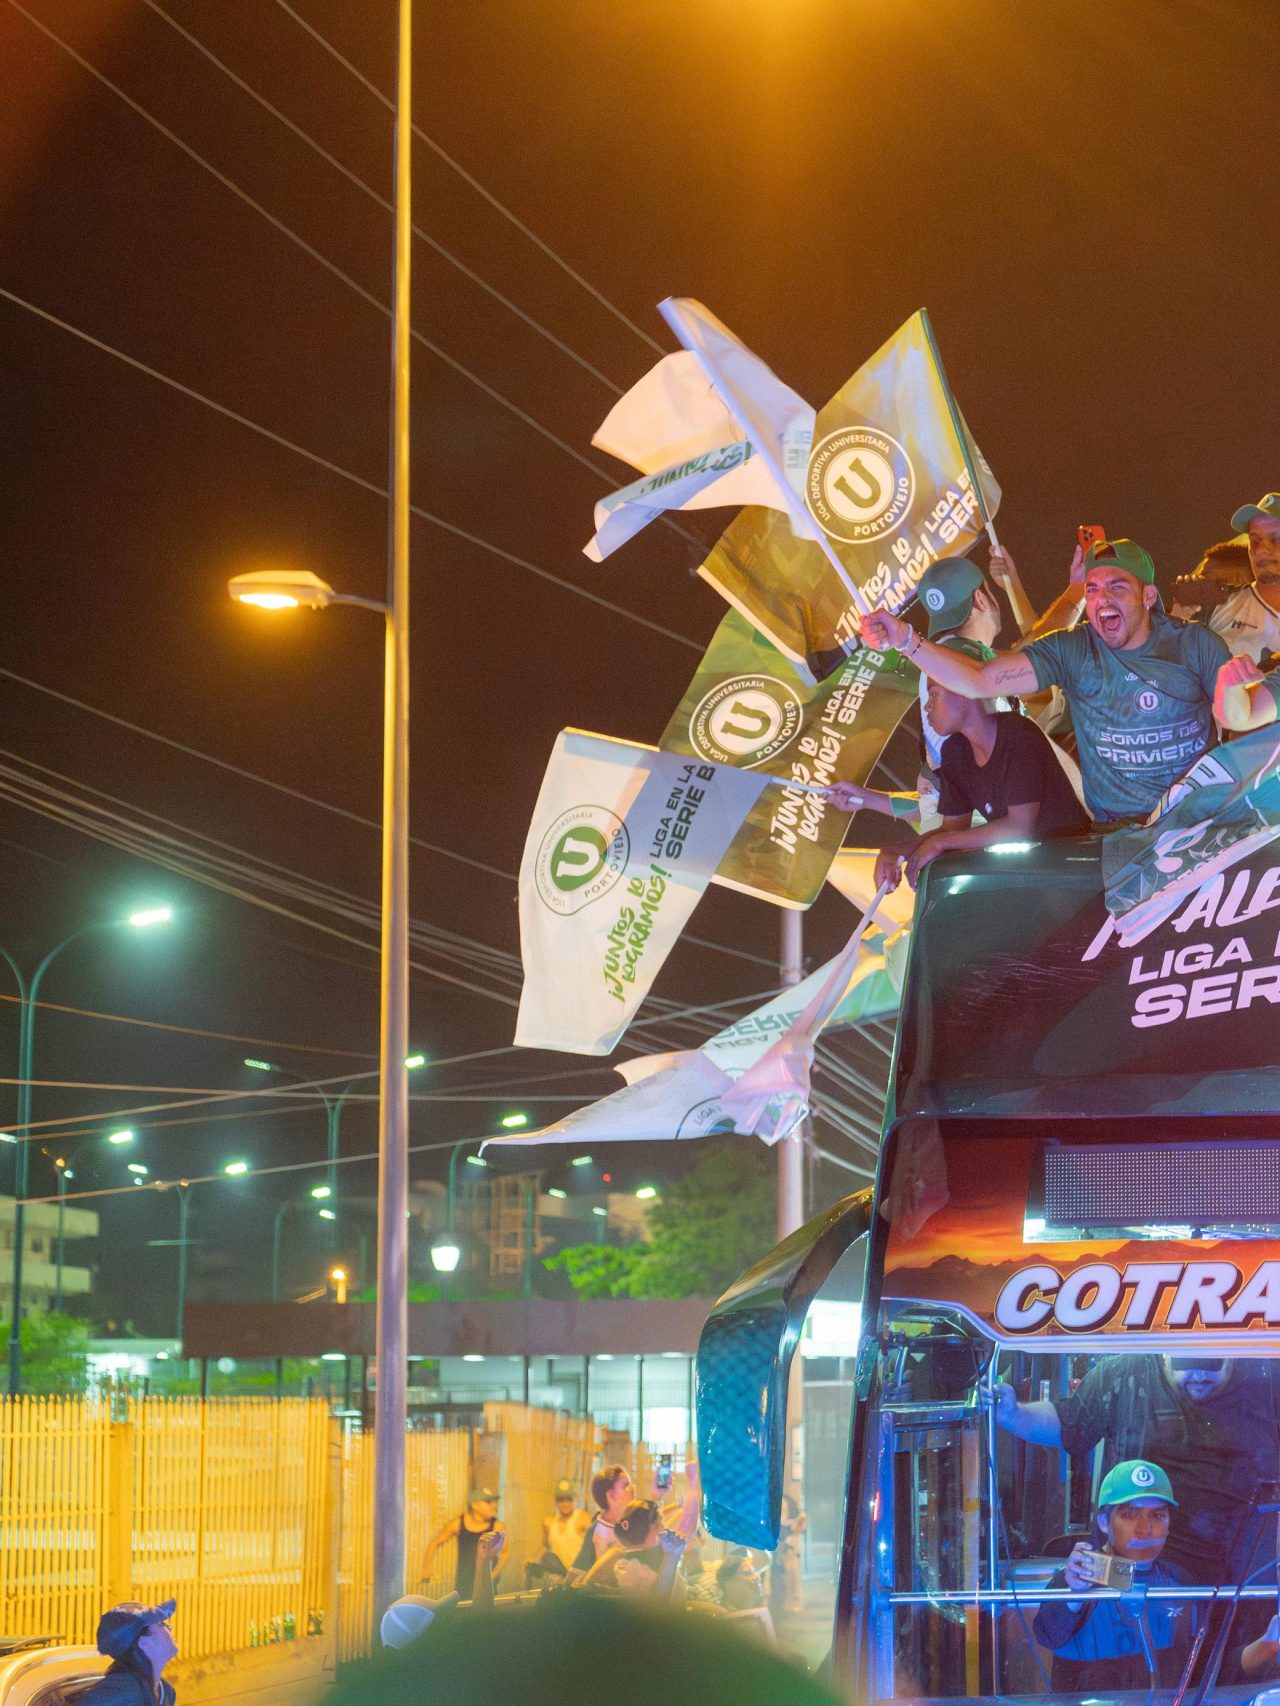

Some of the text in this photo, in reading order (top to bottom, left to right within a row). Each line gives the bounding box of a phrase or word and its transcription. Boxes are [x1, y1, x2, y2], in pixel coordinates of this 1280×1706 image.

[811, 434, 890, 522] LIGA DEPORTIVA UNIVERSITARIA
[833, 457, 881, 508] U
[924, 467, 971, 533] LIGA E
[854, 477, 909, 536] PORTOVIEJO
[938, 490, 980, 543] SER
[891, 536, 912, 564] LO
[706, 680, 765, 709] UNIVERSITARIA
[821, 649, 866, 723] LIGA EN LA
[837, 651, 885, 725] SERIE B
[1143, 695, 1154, 708] U
[720, 701, 772, 739] U
[1100, 721, 1200, 745] SOMOS DE
[798, 736, 819, 757] LO
[1096, 736, 1206, 764] PRIMERA
[649, 764, 697, 859] LIGA EN LA
[665, 765, 716, 859] SERIE B
[556, 837, 600, 877] U
[603, 877, 646, 1003] ¡JUNTOS LO
[621, 863, 672, 984] LOGRAMOS!
[1129, 938, 1252, 985] LIGA
